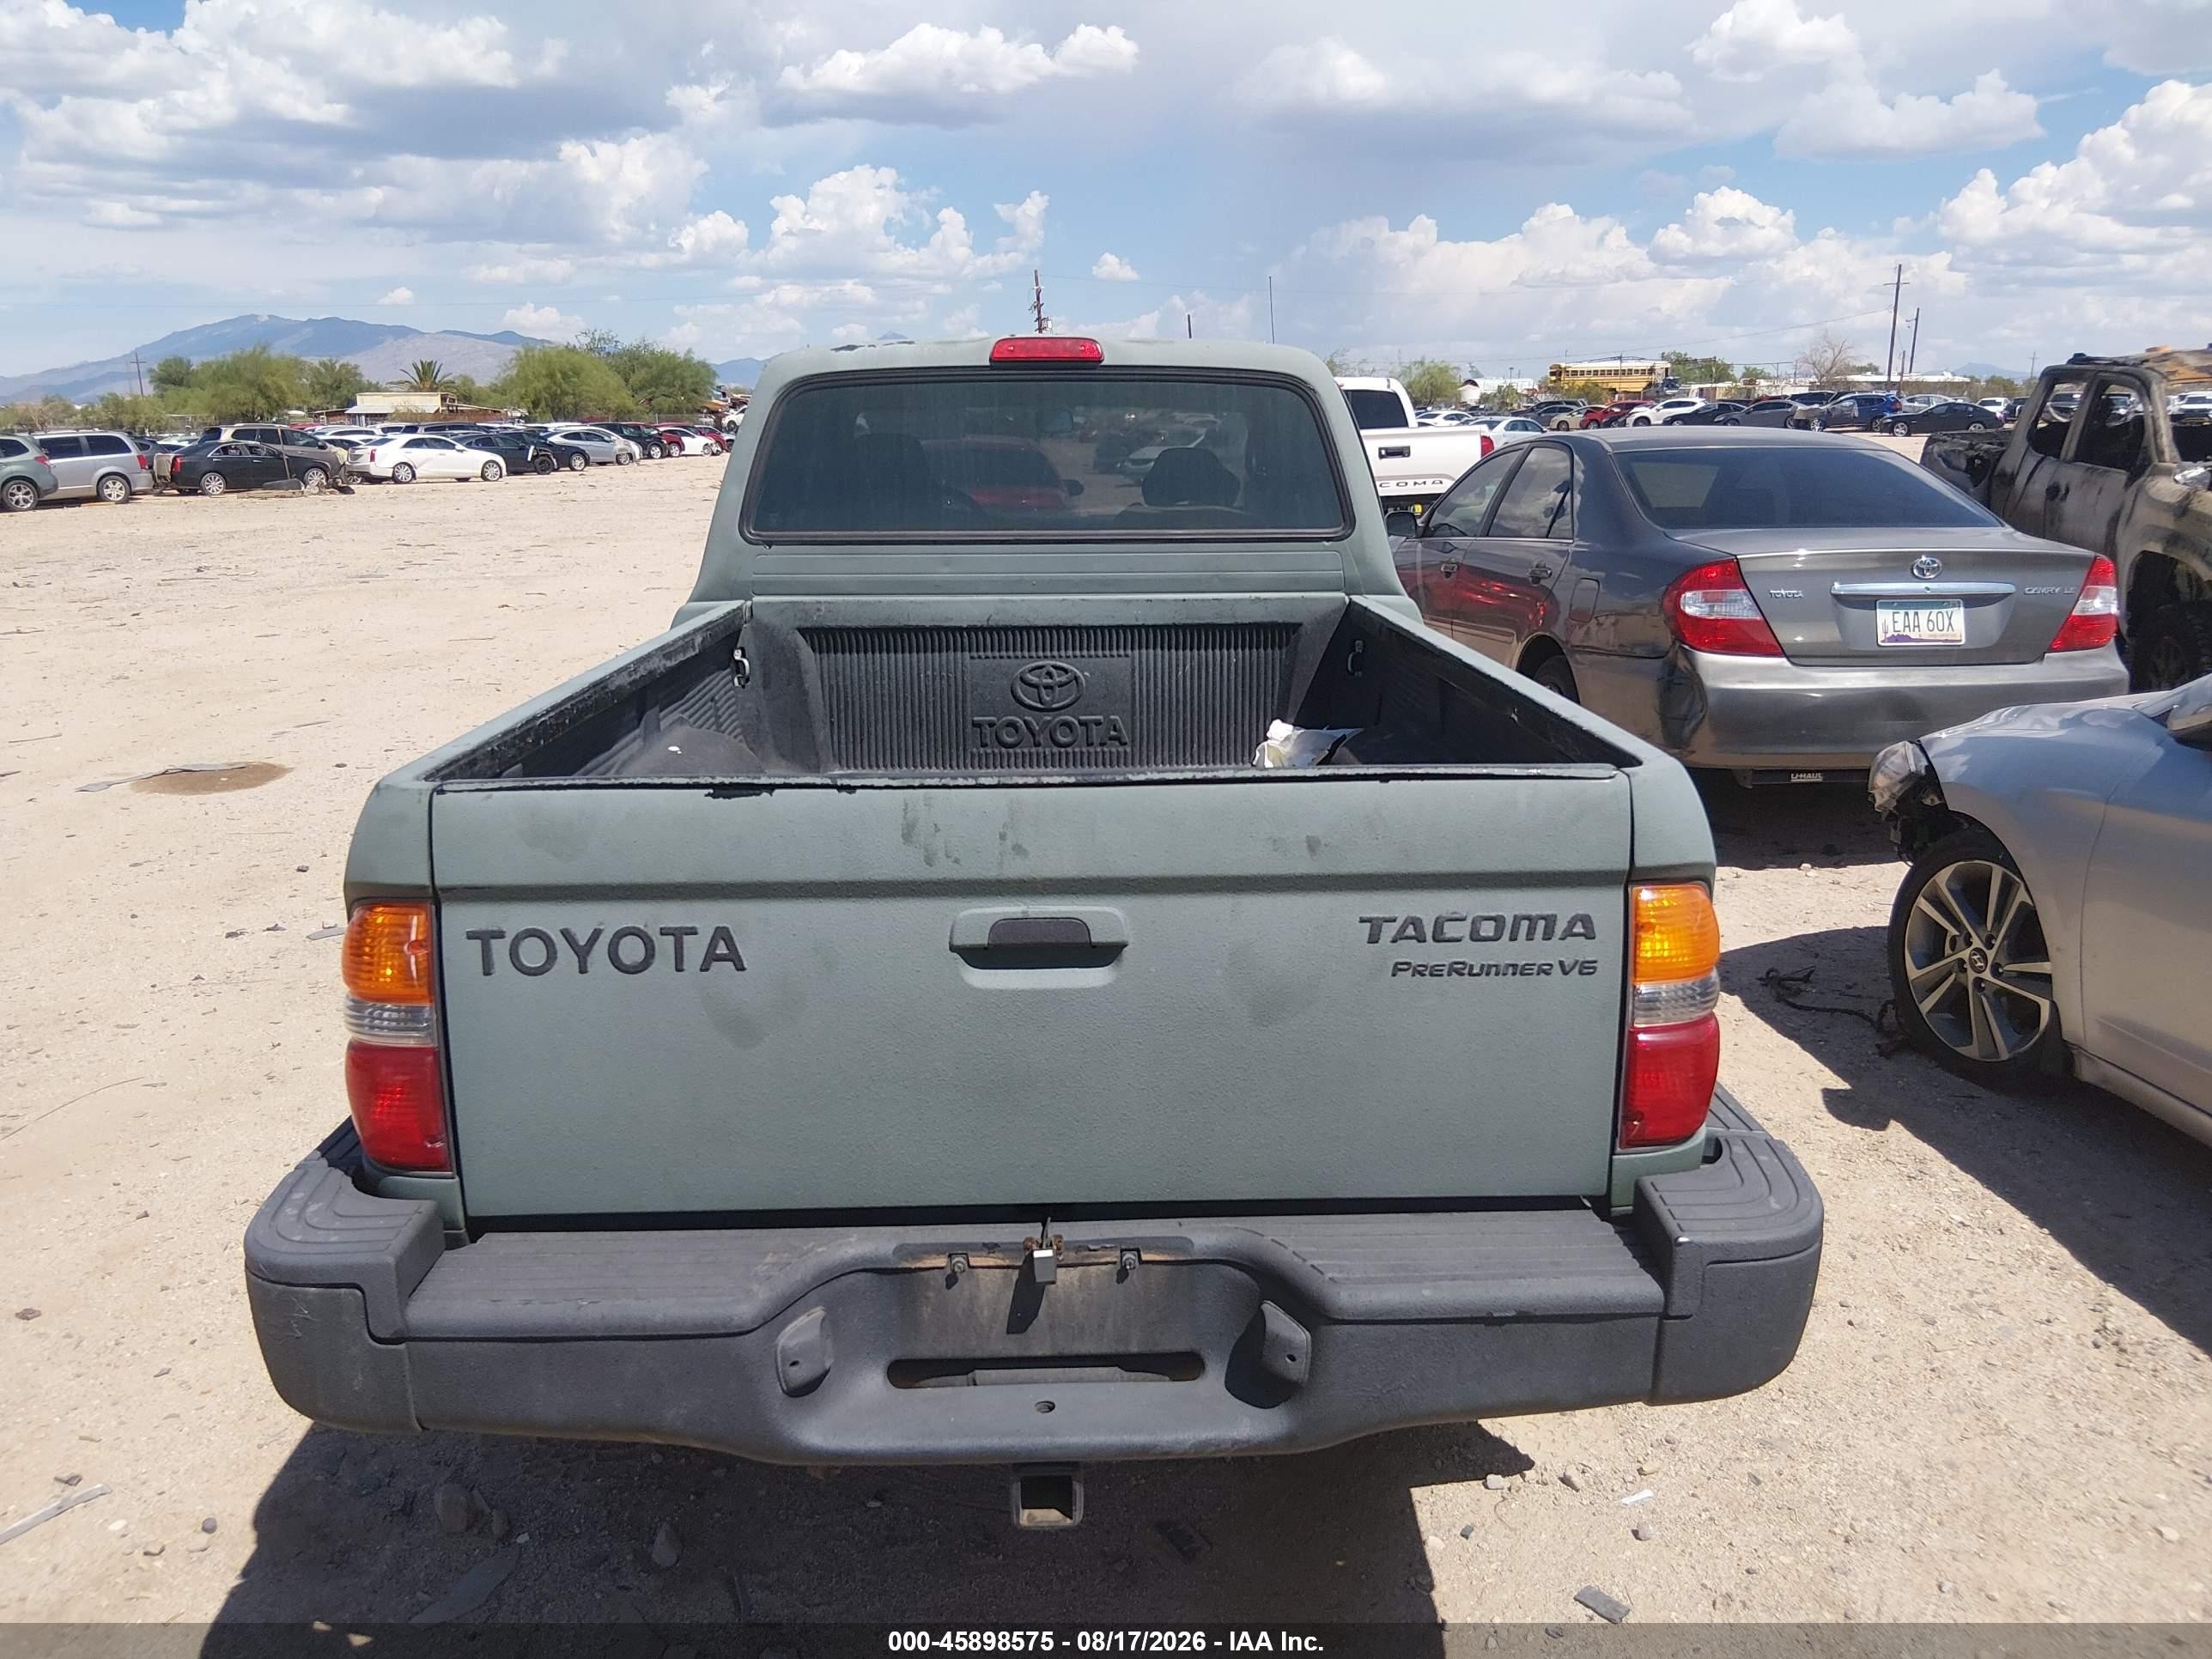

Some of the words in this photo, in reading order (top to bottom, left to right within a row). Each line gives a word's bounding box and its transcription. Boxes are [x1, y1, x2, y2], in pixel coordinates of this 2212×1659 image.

[1379, 479, 1443, 489] COMA
[1769, 588, 1804, 599] TOYOTA
[2024, 586, 2060, 595] CAMRY
[1892, 611, 1922, 633] EAA
[1926, 611, 1955, 633] 60X
[971, 715, 1129, 750] TOYOTA
[1358, 913, 1597, 944] TACOMA
[465, 925, 748, 976] TOYOTA
[1558, 958, 1598, 976] V6
